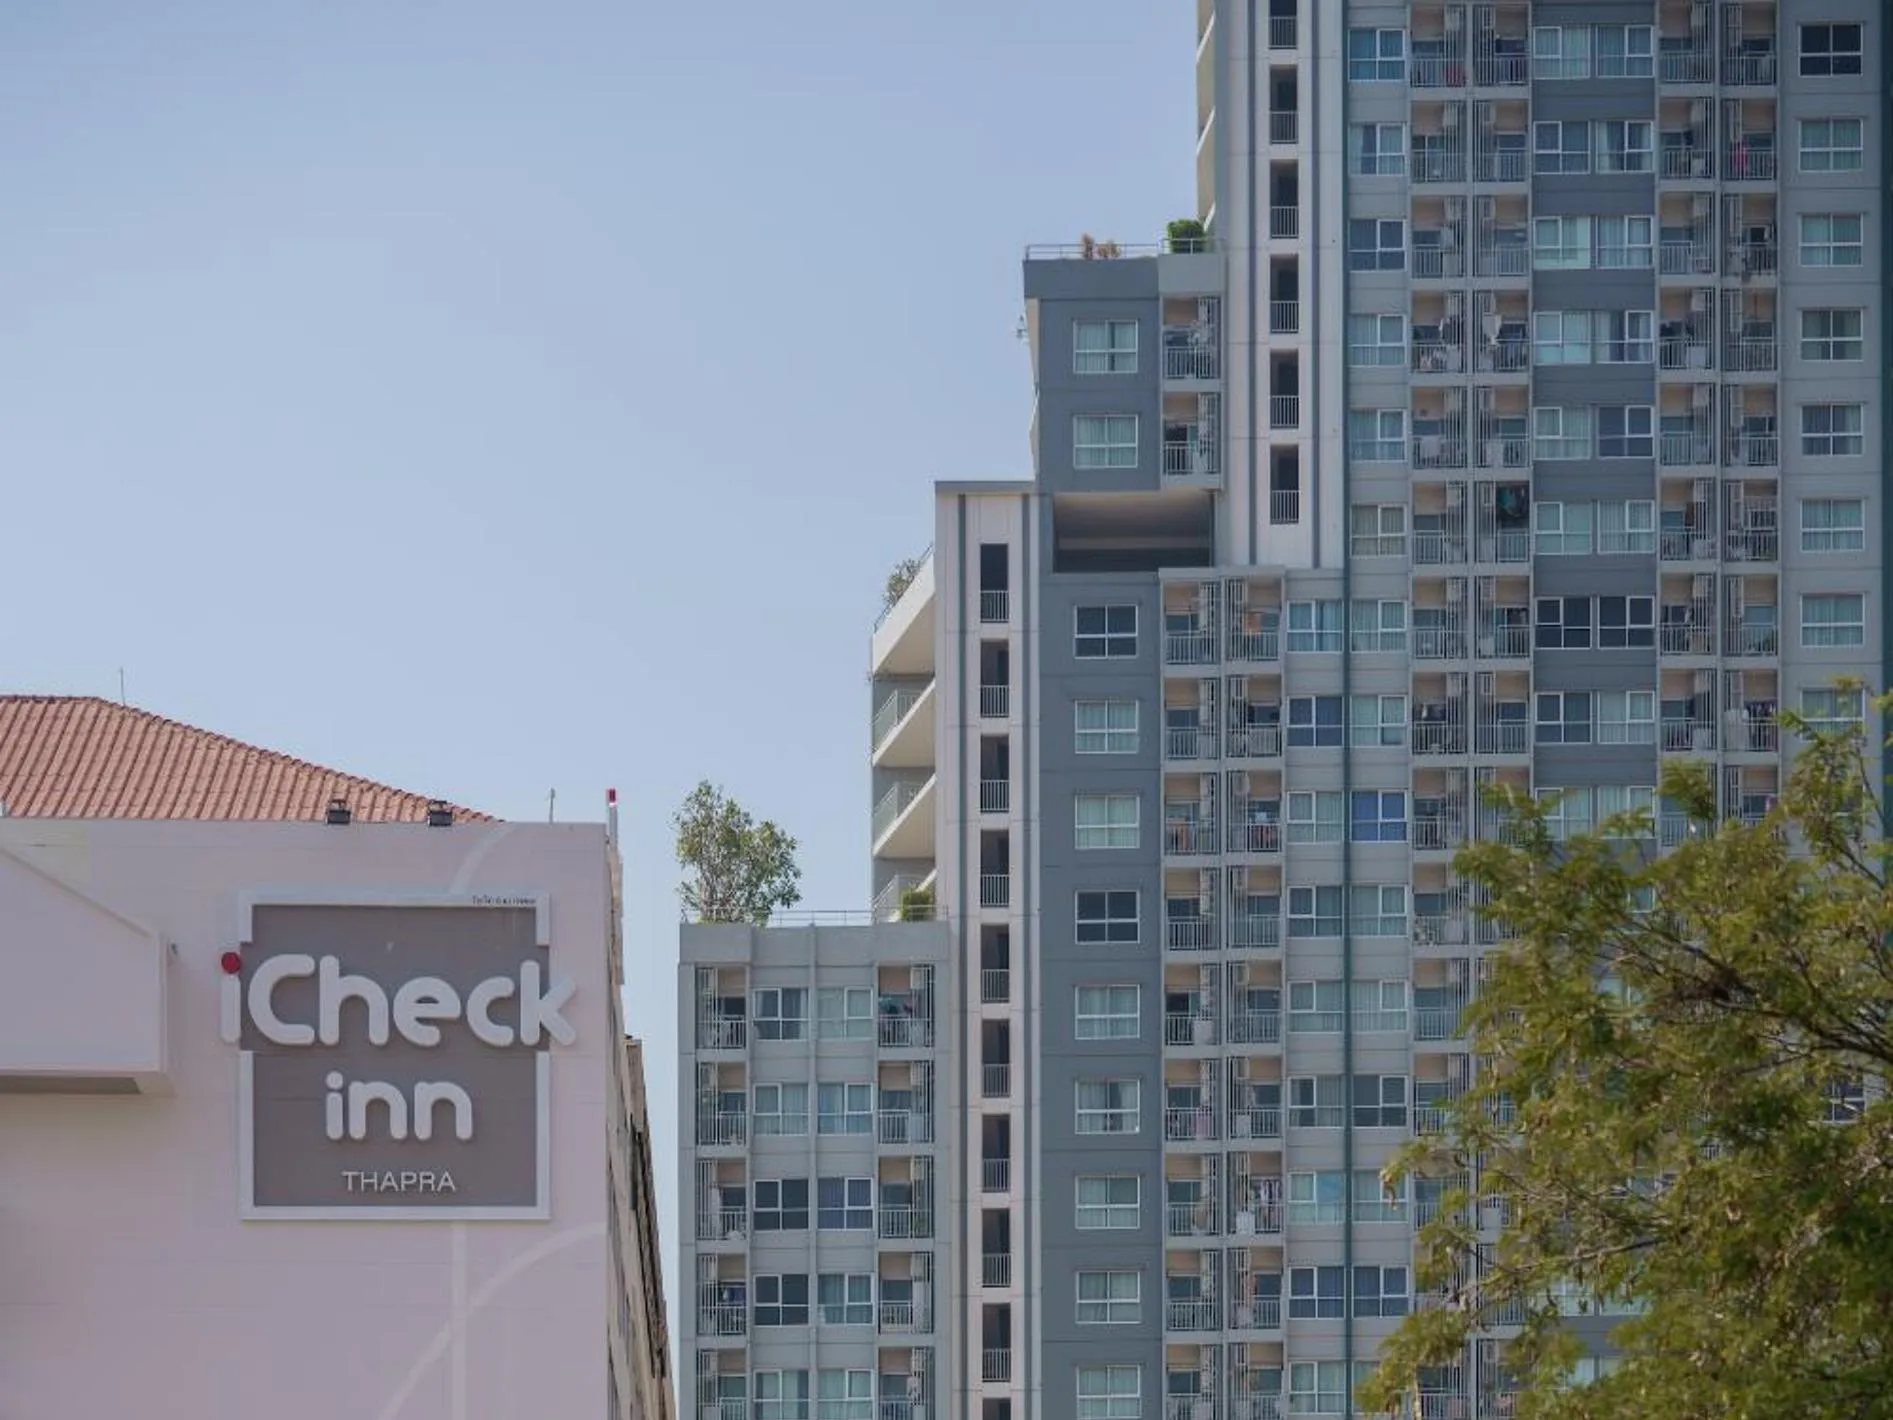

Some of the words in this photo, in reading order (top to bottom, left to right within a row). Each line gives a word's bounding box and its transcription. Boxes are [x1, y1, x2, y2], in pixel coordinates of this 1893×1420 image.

[219, 951, 577, 1048] iCheck
[325, 1071, 474, 1141] inn
[341, 1170, 457, 1192] THAPRA
